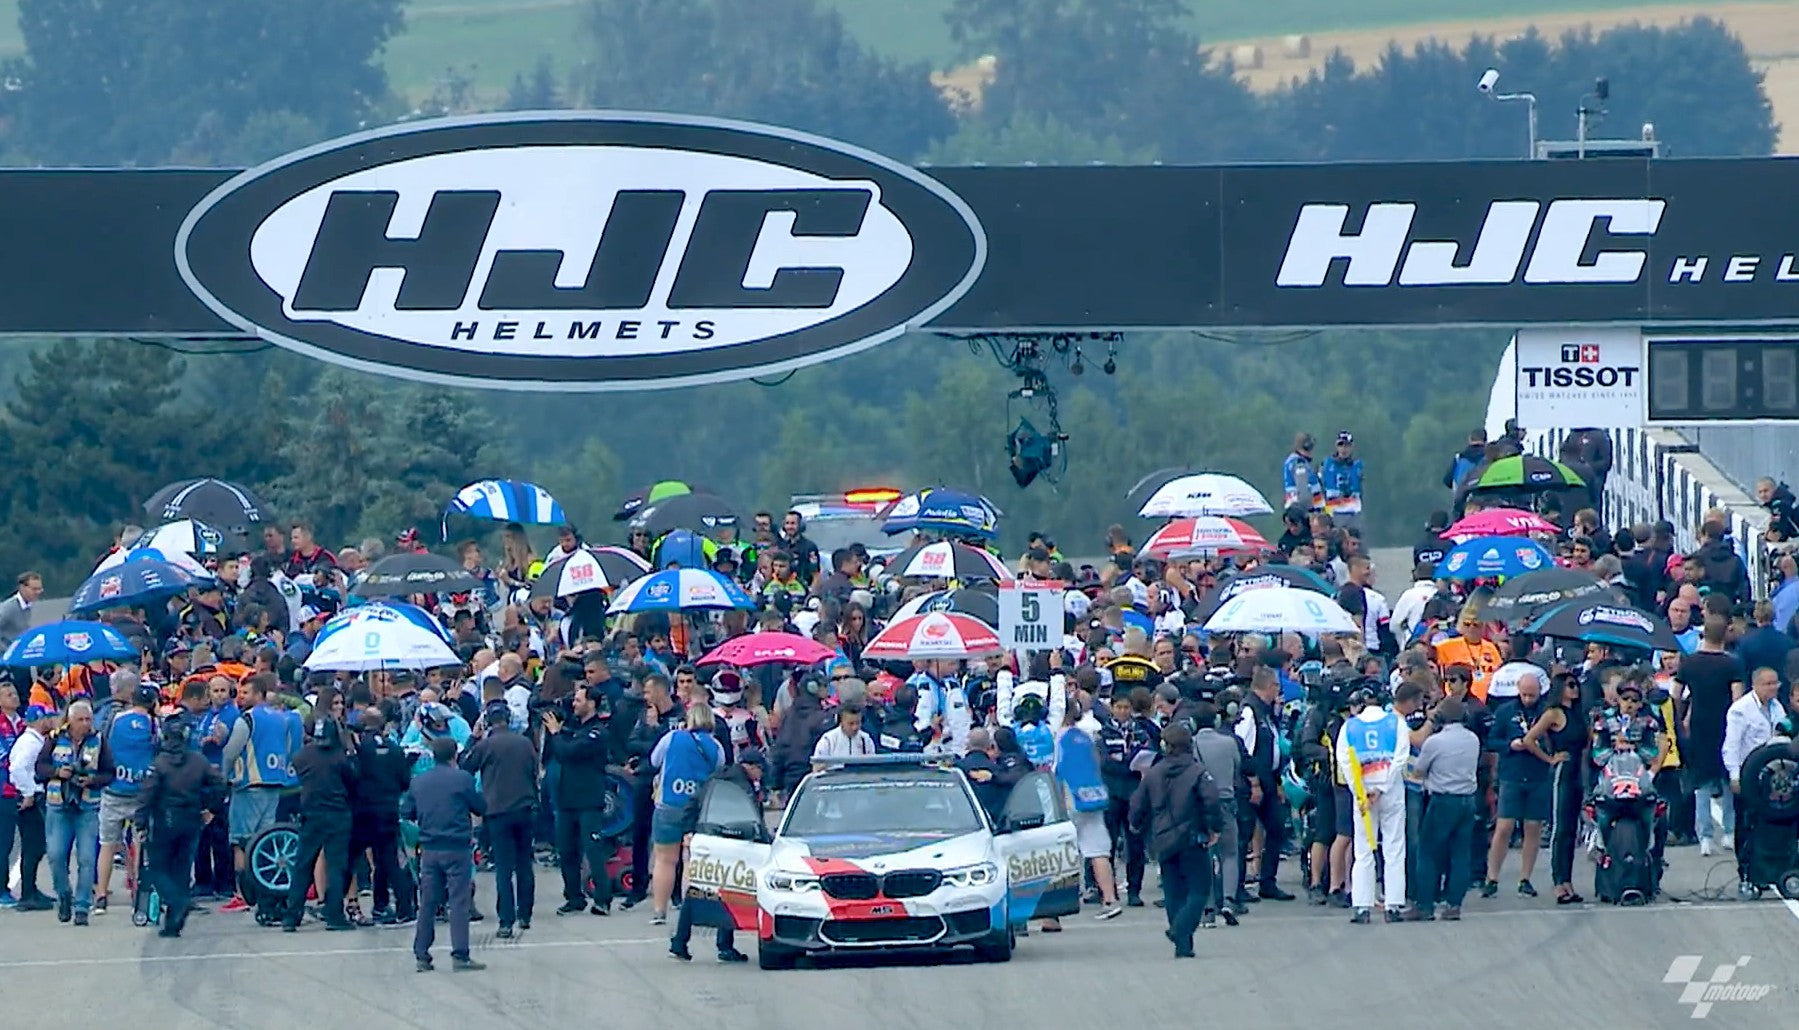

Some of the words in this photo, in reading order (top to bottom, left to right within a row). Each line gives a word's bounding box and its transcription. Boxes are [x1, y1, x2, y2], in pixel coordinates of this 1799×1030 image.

[290, 190, 872, 311] HJC
[1276, 199, 1667, 287] HJC
[450, 320, 716, 341] HELMETS
[1522, 367, 1639, 387] TISSOT
[1021, 592, 1040, 622] 5
[1014, 624, 1047, 643] MIN
[689, 856, 731, 886] afety
[1008, 848, 1063, 879] Safety
[1065, 840, 1080, 867] C
